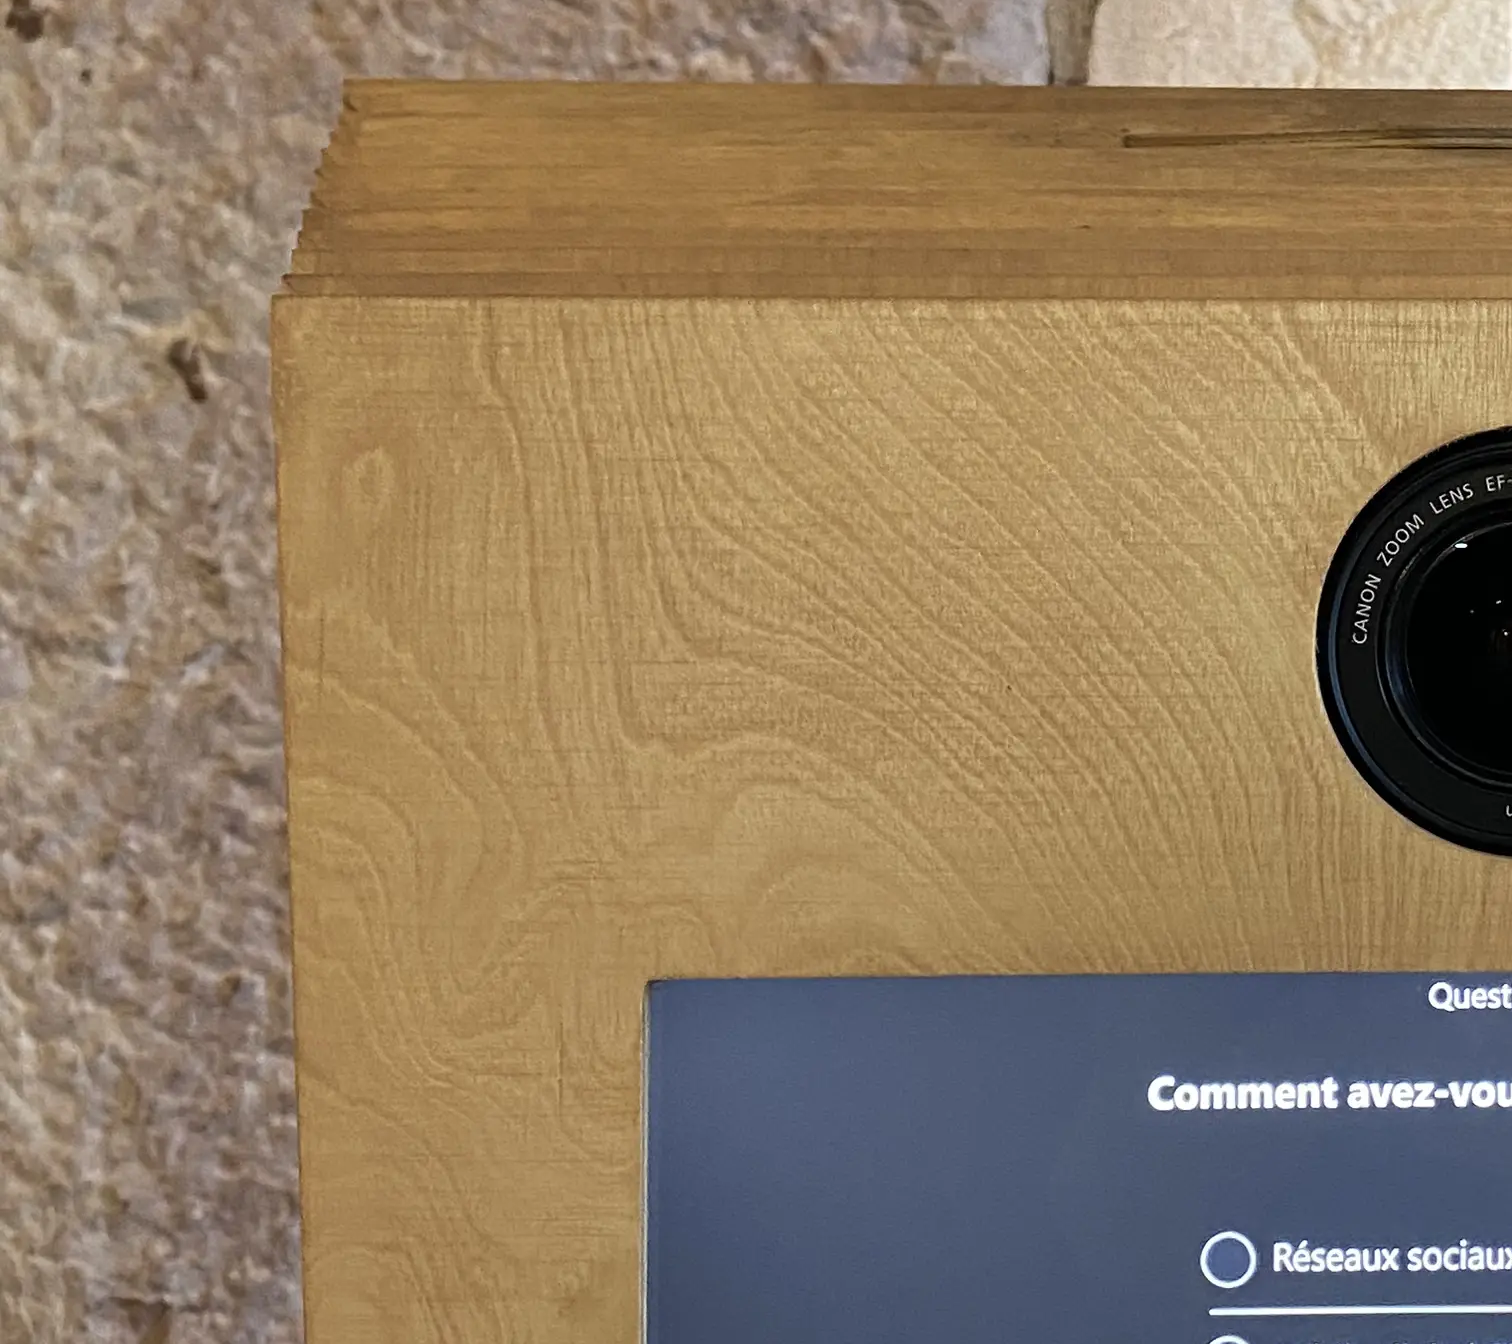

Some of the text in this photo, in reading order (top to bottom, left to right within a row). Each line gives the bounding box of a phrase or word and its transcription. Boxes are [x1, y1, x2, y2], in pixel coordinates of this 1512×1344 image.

[1351, 573, 1381, 644] CANON
[1376, 514, 1425, 567] ZOOM
[1429, 483, 1474, 514] LENS
[1147, 1074, 1339, 1112] Comment
[1273, 1239, 1399, 1273] Réseaux
